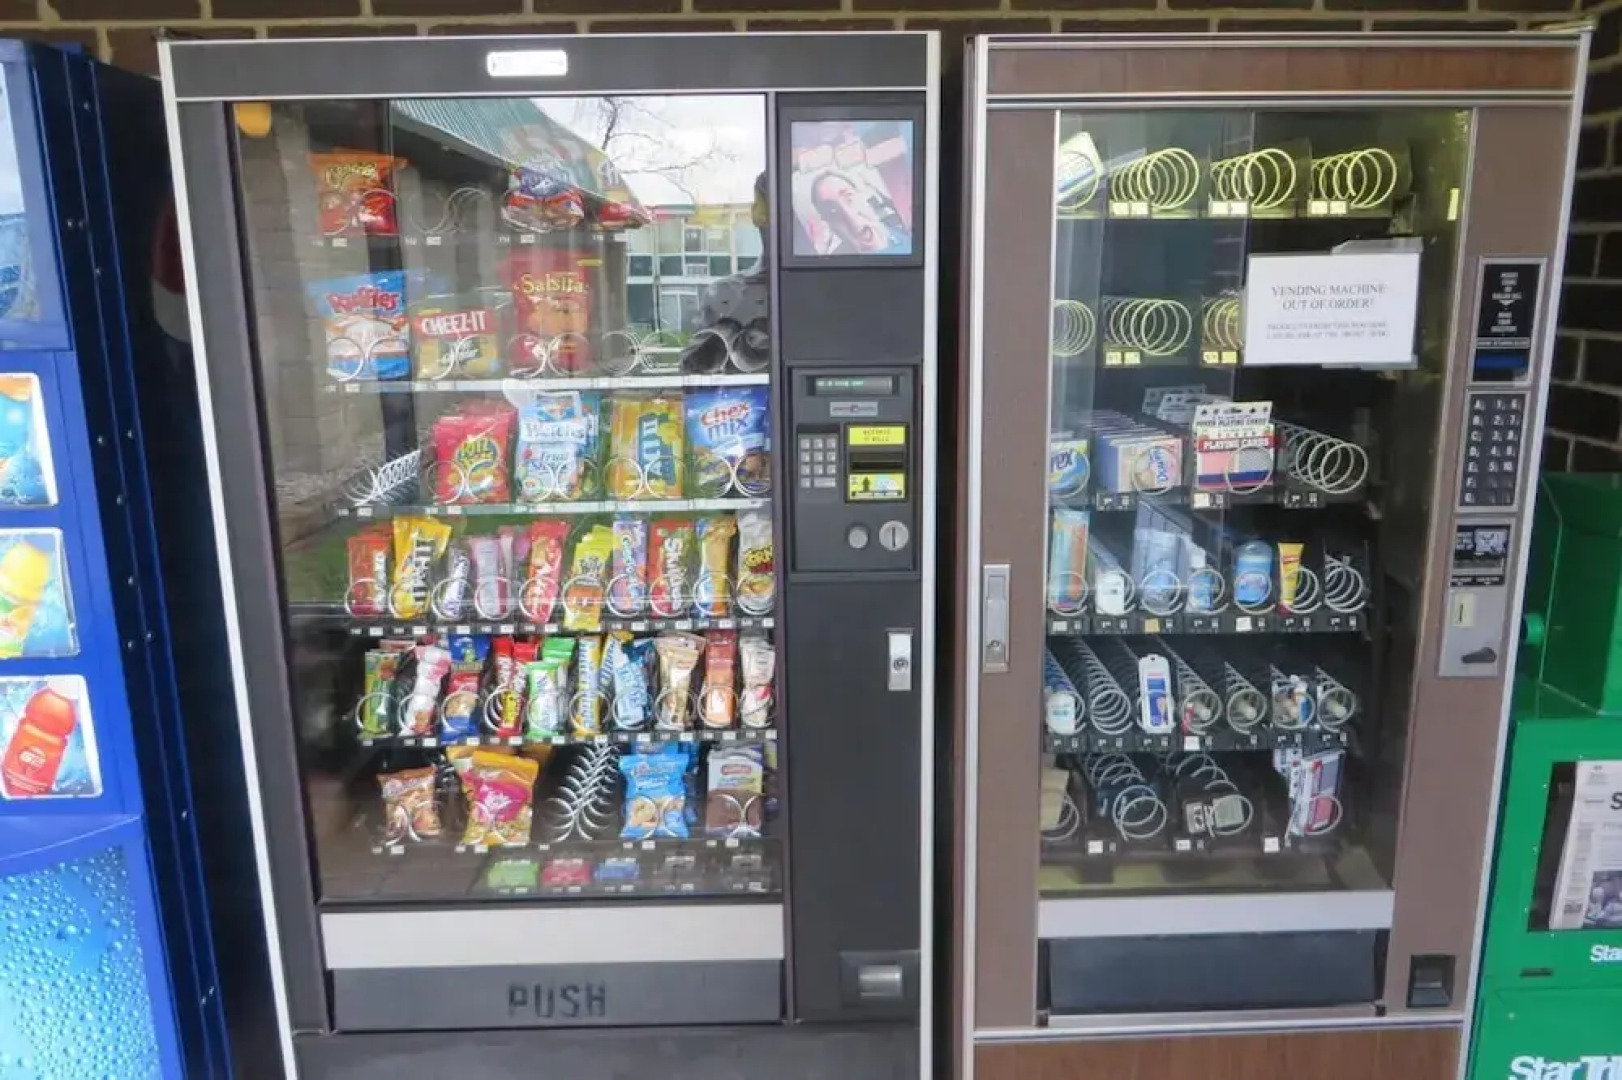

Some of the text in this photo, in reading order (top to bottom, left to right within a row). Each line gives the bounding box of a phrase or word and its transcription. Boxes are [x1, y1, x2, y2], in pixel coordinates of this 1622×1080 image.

[1272, 284, 1386, 297] VENDING MACHINE
[1282, 299, 1307, 310] OUT
[1310, 299, 1324, 310] OF
[421, 311, 486, 335] CHEEZ-IT
[700, 401, 750, 426] Chex
[509, 984, 606, 1018] PUSH
